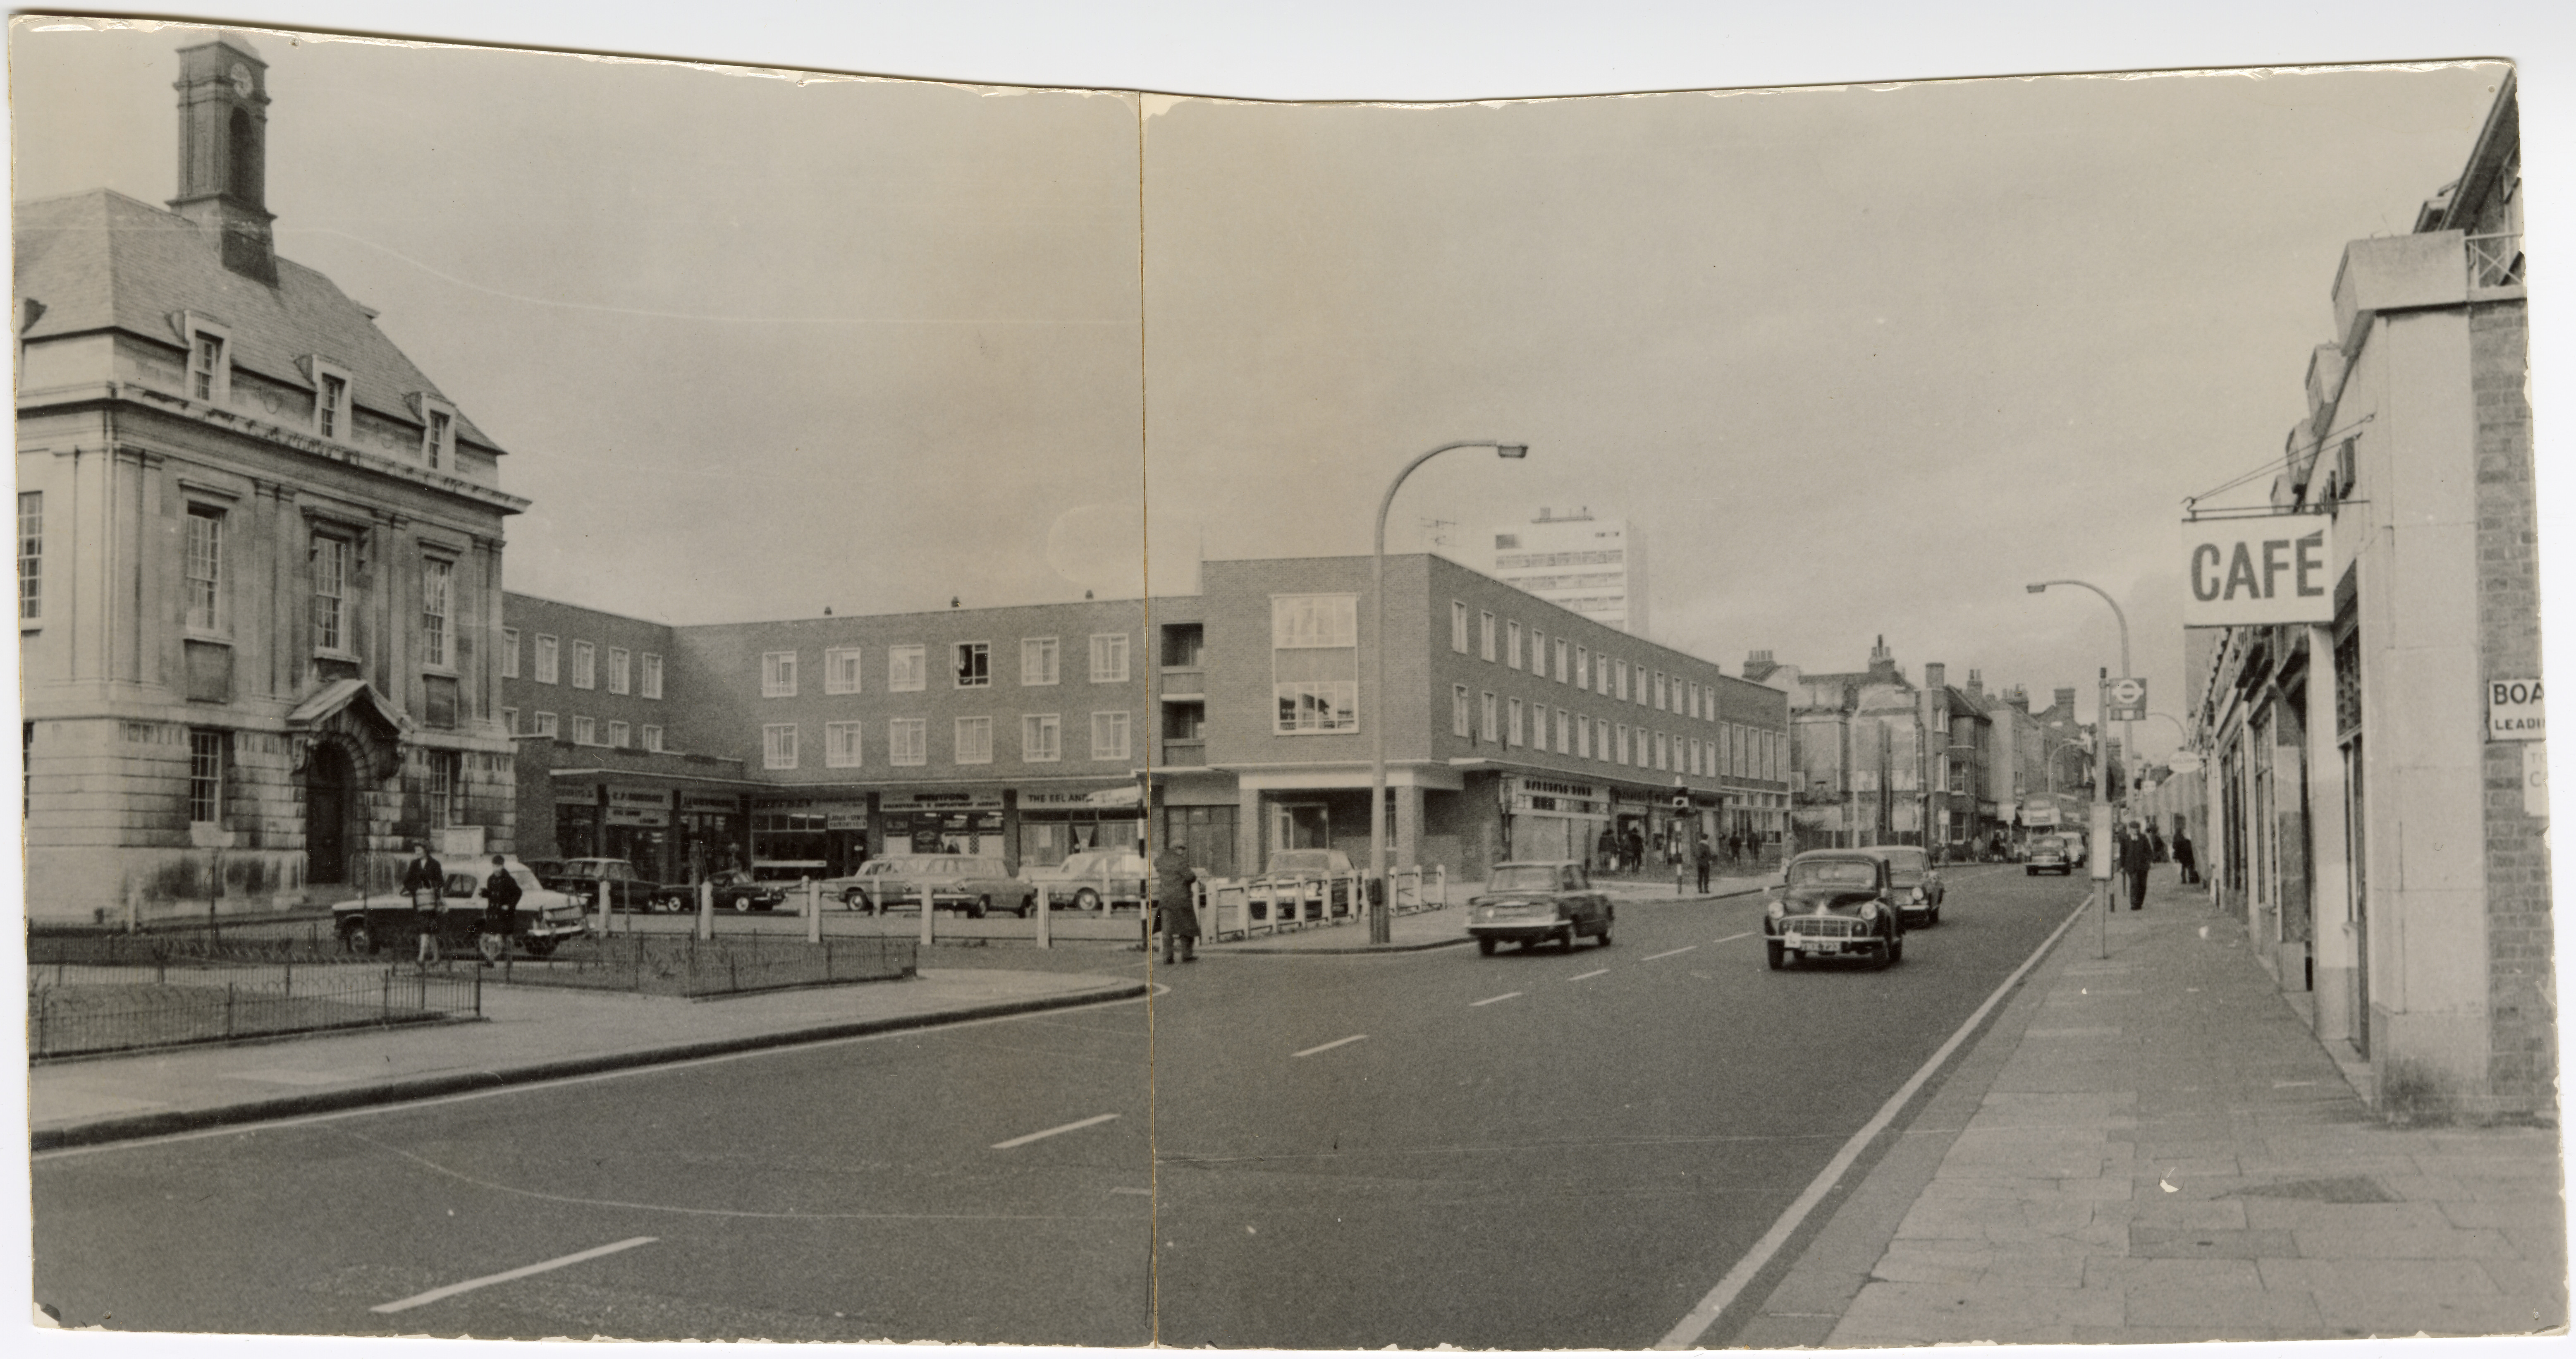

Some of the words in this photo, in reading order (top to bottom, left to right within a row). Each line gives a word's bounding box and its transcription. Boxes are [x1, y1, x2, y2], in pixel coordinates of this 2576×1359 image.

[2191, 529, 2324, 602] CAFÉ
[1028, 794, 1045, 803] THE
[1049, 793, 1066, 802] EEL
